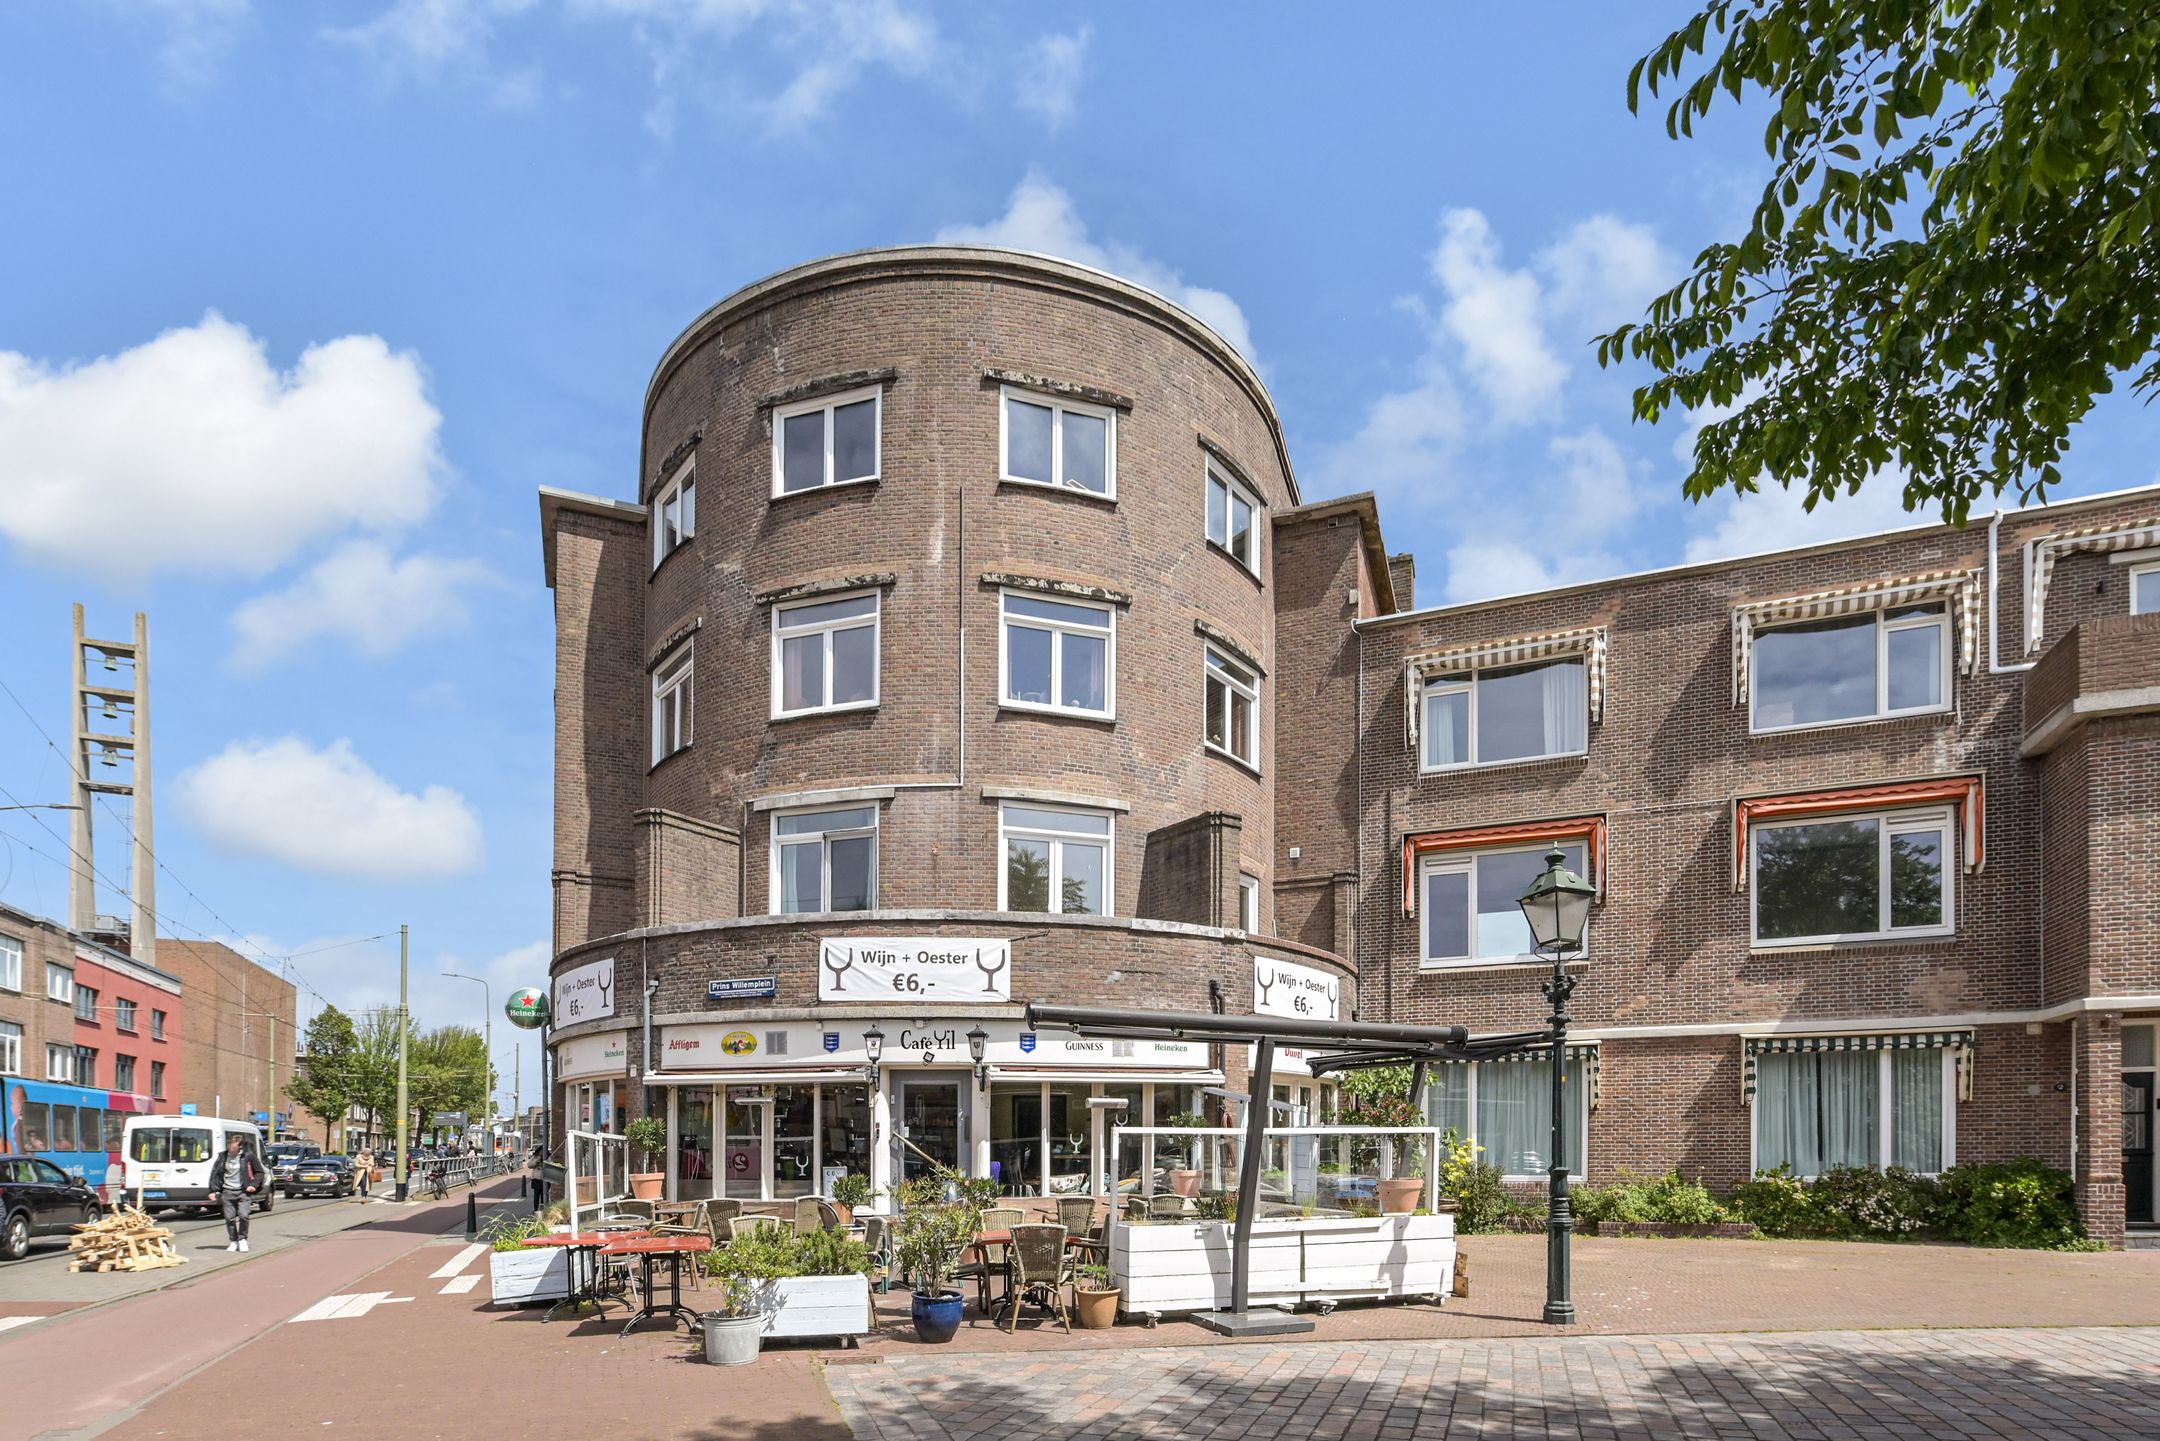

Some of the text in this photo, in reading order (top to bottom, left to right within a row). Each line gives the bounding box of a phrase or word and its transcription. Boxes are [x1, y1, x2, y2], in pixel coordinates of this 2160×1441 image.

[861, 951, 968, 967] Wijn + Oester
[562, 984, 572, 998] Wijn
[576, 977, 595, 990] Oester
[732, 980, 771, 989] Willemplein
[892, 973, 935, 995] €6,-
[1278, 973, 1297, 989] Wijn
[1305, 979, 1325, 994] Oester
[510, 1009, 546, 1017] Heineken
[570, 999, 584, 1016] €6,-
[1294, 996, 1313, 1016] €6,-
[669, 1040, 700, 1051] Affligem
[900, 1030, 956, 1050] Café Yil
[1065, 1041, 1104, 1051] GUINNESS
[1154, 1043, 1188, 1052] Heineken
[604, 1049, 624, 1058] Heineken
